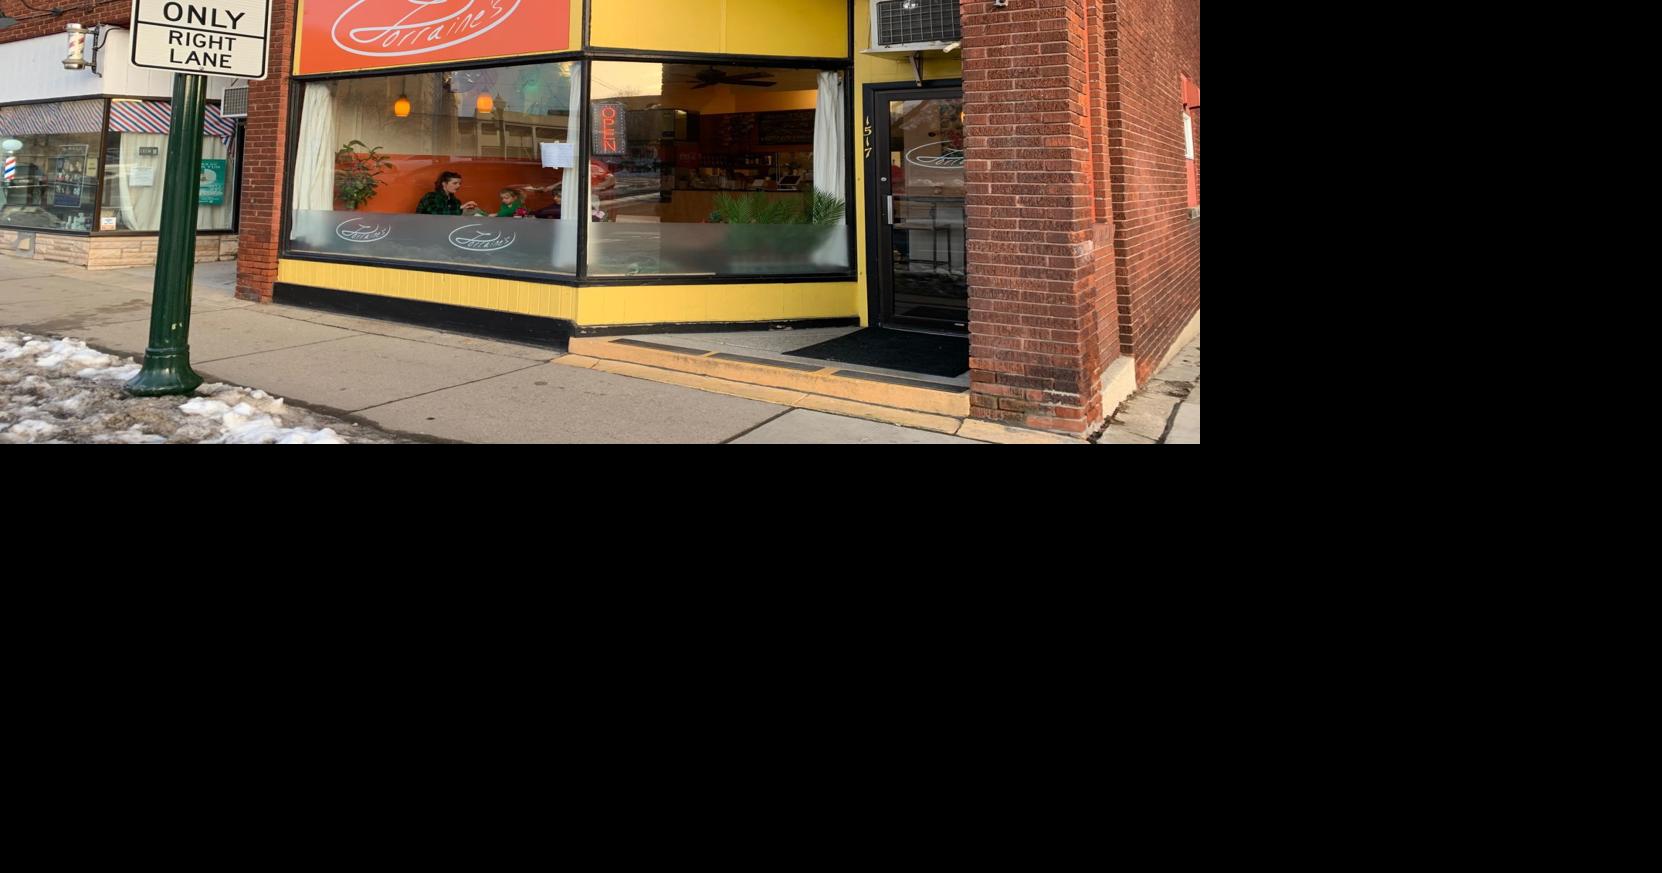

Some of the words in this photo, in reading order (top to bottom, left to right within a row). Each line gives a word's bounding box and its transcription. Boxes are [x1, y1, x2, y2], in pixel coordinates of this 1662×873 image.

[163, 2, 245, 29] ONLY
[169, 30, 236, 51] RIGHT
[170, 48, 232, 69] LANE
[601, 107, 616, 153] OPEN
[863, 115, 872, 159] 1517
